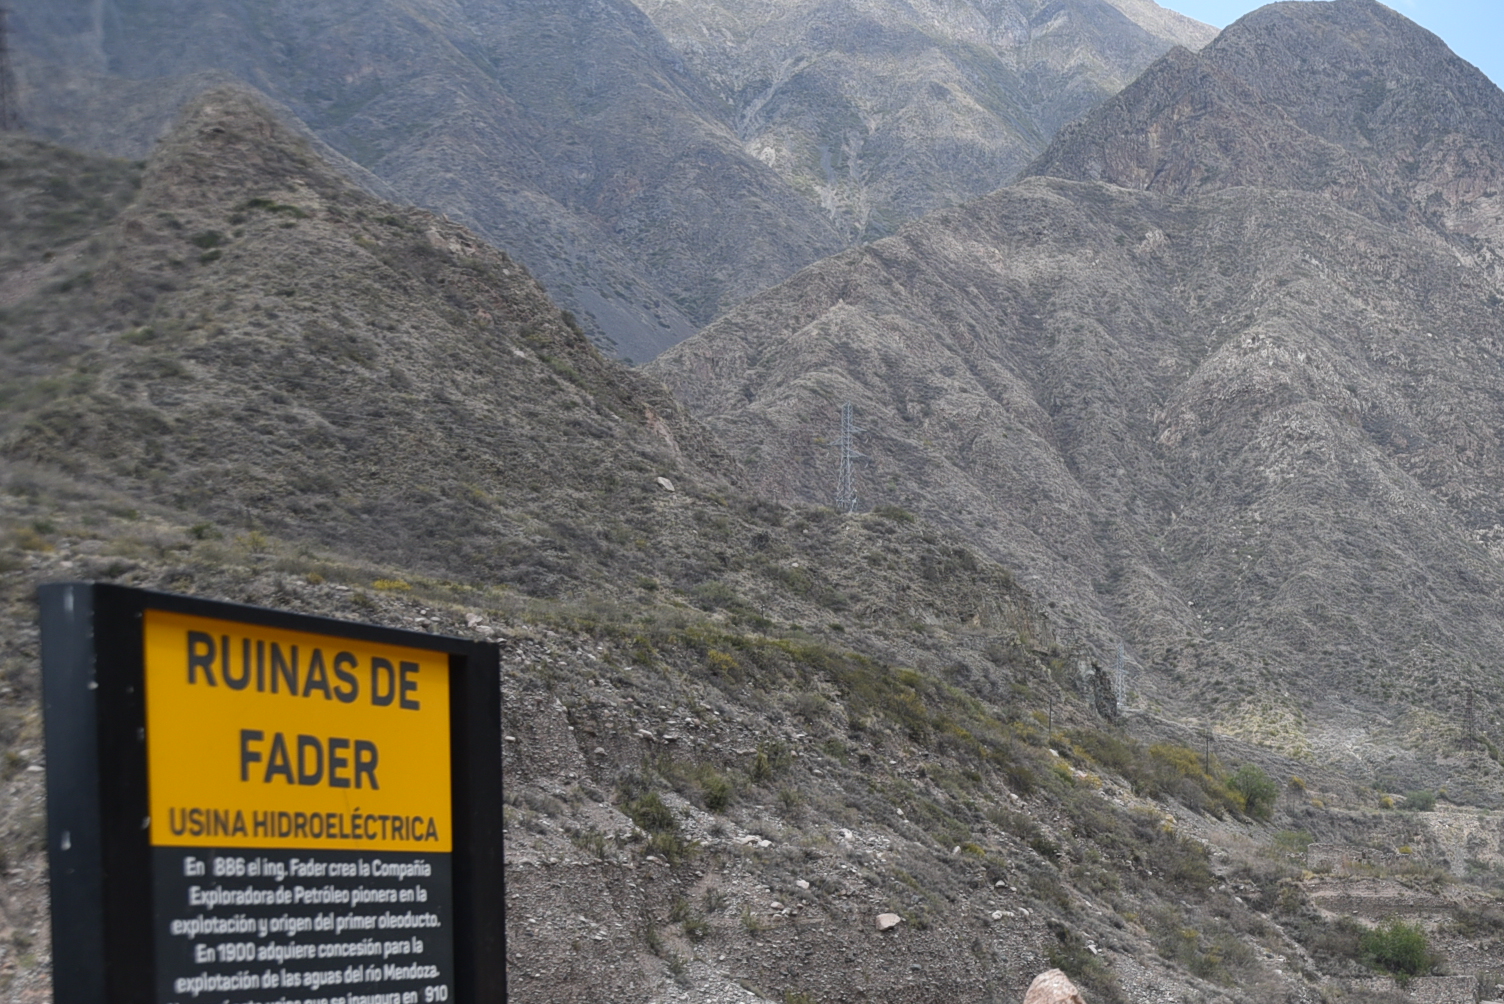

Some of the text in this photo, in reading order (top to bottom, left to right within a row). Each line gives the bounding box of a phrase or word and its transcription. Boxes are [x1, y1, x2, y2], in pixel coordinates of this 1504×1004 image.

[187, 630, 420, 711] RUINAS DE
[240, 728, 380, 790] FADER
[169, 807, 439, 841] USINA HIDROELÉCTRICA
[184, 856, 205, 877] En
[247, 857, 261, 877] el
[262, 857, 288, 882] ing.
[290, 858, 327, 877] Fader
[328, 862, 356, 877] crea
[358, 858, 370, 877] la
[372, 859, 431, 881] Compañía
[188, 885, 427, 910] Exploradora de Petróleo pionera en la
[170, 910, 441, 939] explotación y origen del primer oleoducto.
[194, 936, 424, 965] En 1900 adquiere concesión para la
[174, 961, 440, 997] explotación de las aguas del río Mendoza.
